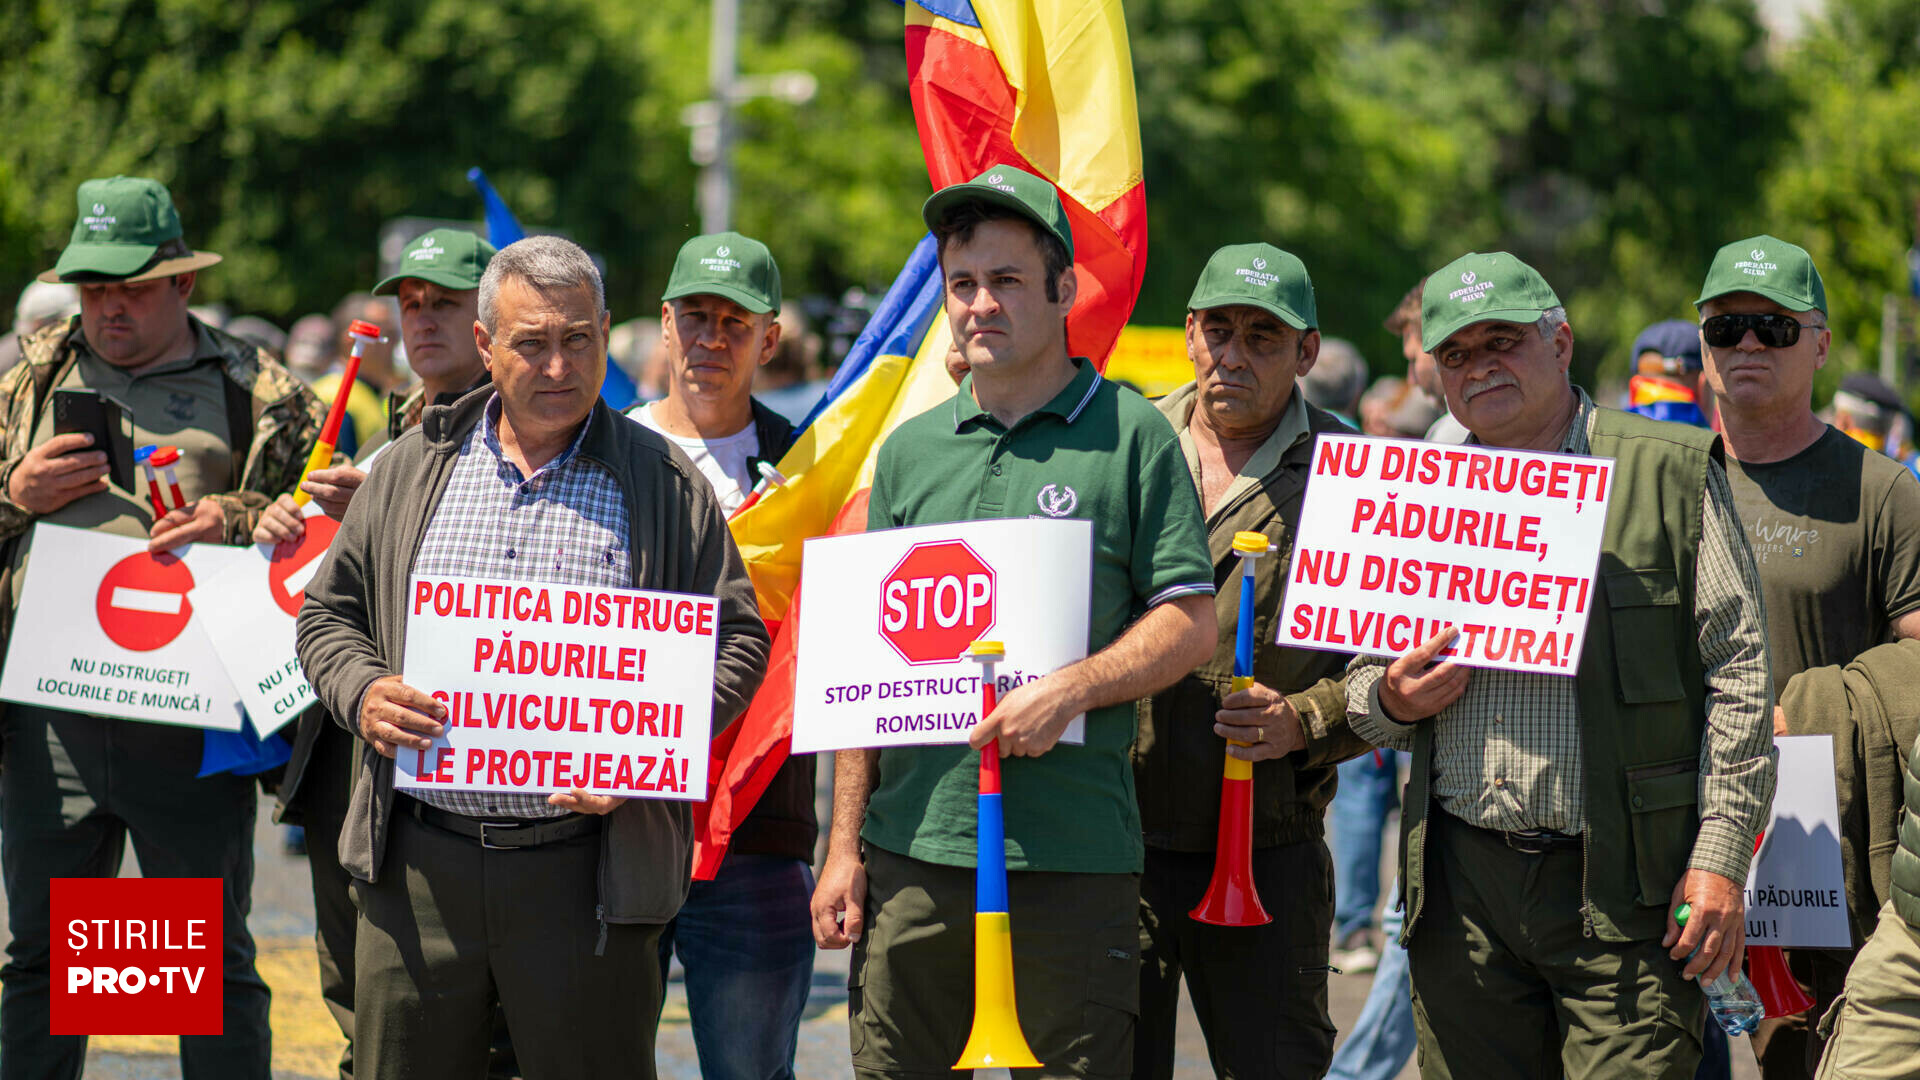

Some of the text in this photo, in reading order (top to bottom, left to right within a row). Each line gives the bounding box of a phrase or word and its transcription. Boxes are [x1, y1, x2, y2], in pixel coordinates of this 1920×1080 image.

[1316, 441, 1609, 514] NU DISTRUGEȚI
[1351, 492, 1548, 563] PĂDURILE,
[414, 581, 714, 636] POLITICA DISTRUGE
[883, 573, 991, 633] STOP
[1295, 548, 1589, 625] NU DISTRUGEȚI
[70, 657, 190, 689] NU DISTRUGEȚI
[473, 630, 647, 682] PĂDURILE!
[36, 677, 211, 713] LOCURILE DE MUNCĂ !
[258, 669, 282, 694] NU
[274, 693, 295, 715] CU
[824, 683, 872, 704] STOP
[431, 690, 684, 738] SILVICULTORII
[876, 712, 978, 734] ROMSILVA
[415, 747, 689, 793] LE PROTEJEAZĂ!
[1757, 883, 1840, 908] PĂDURILE
